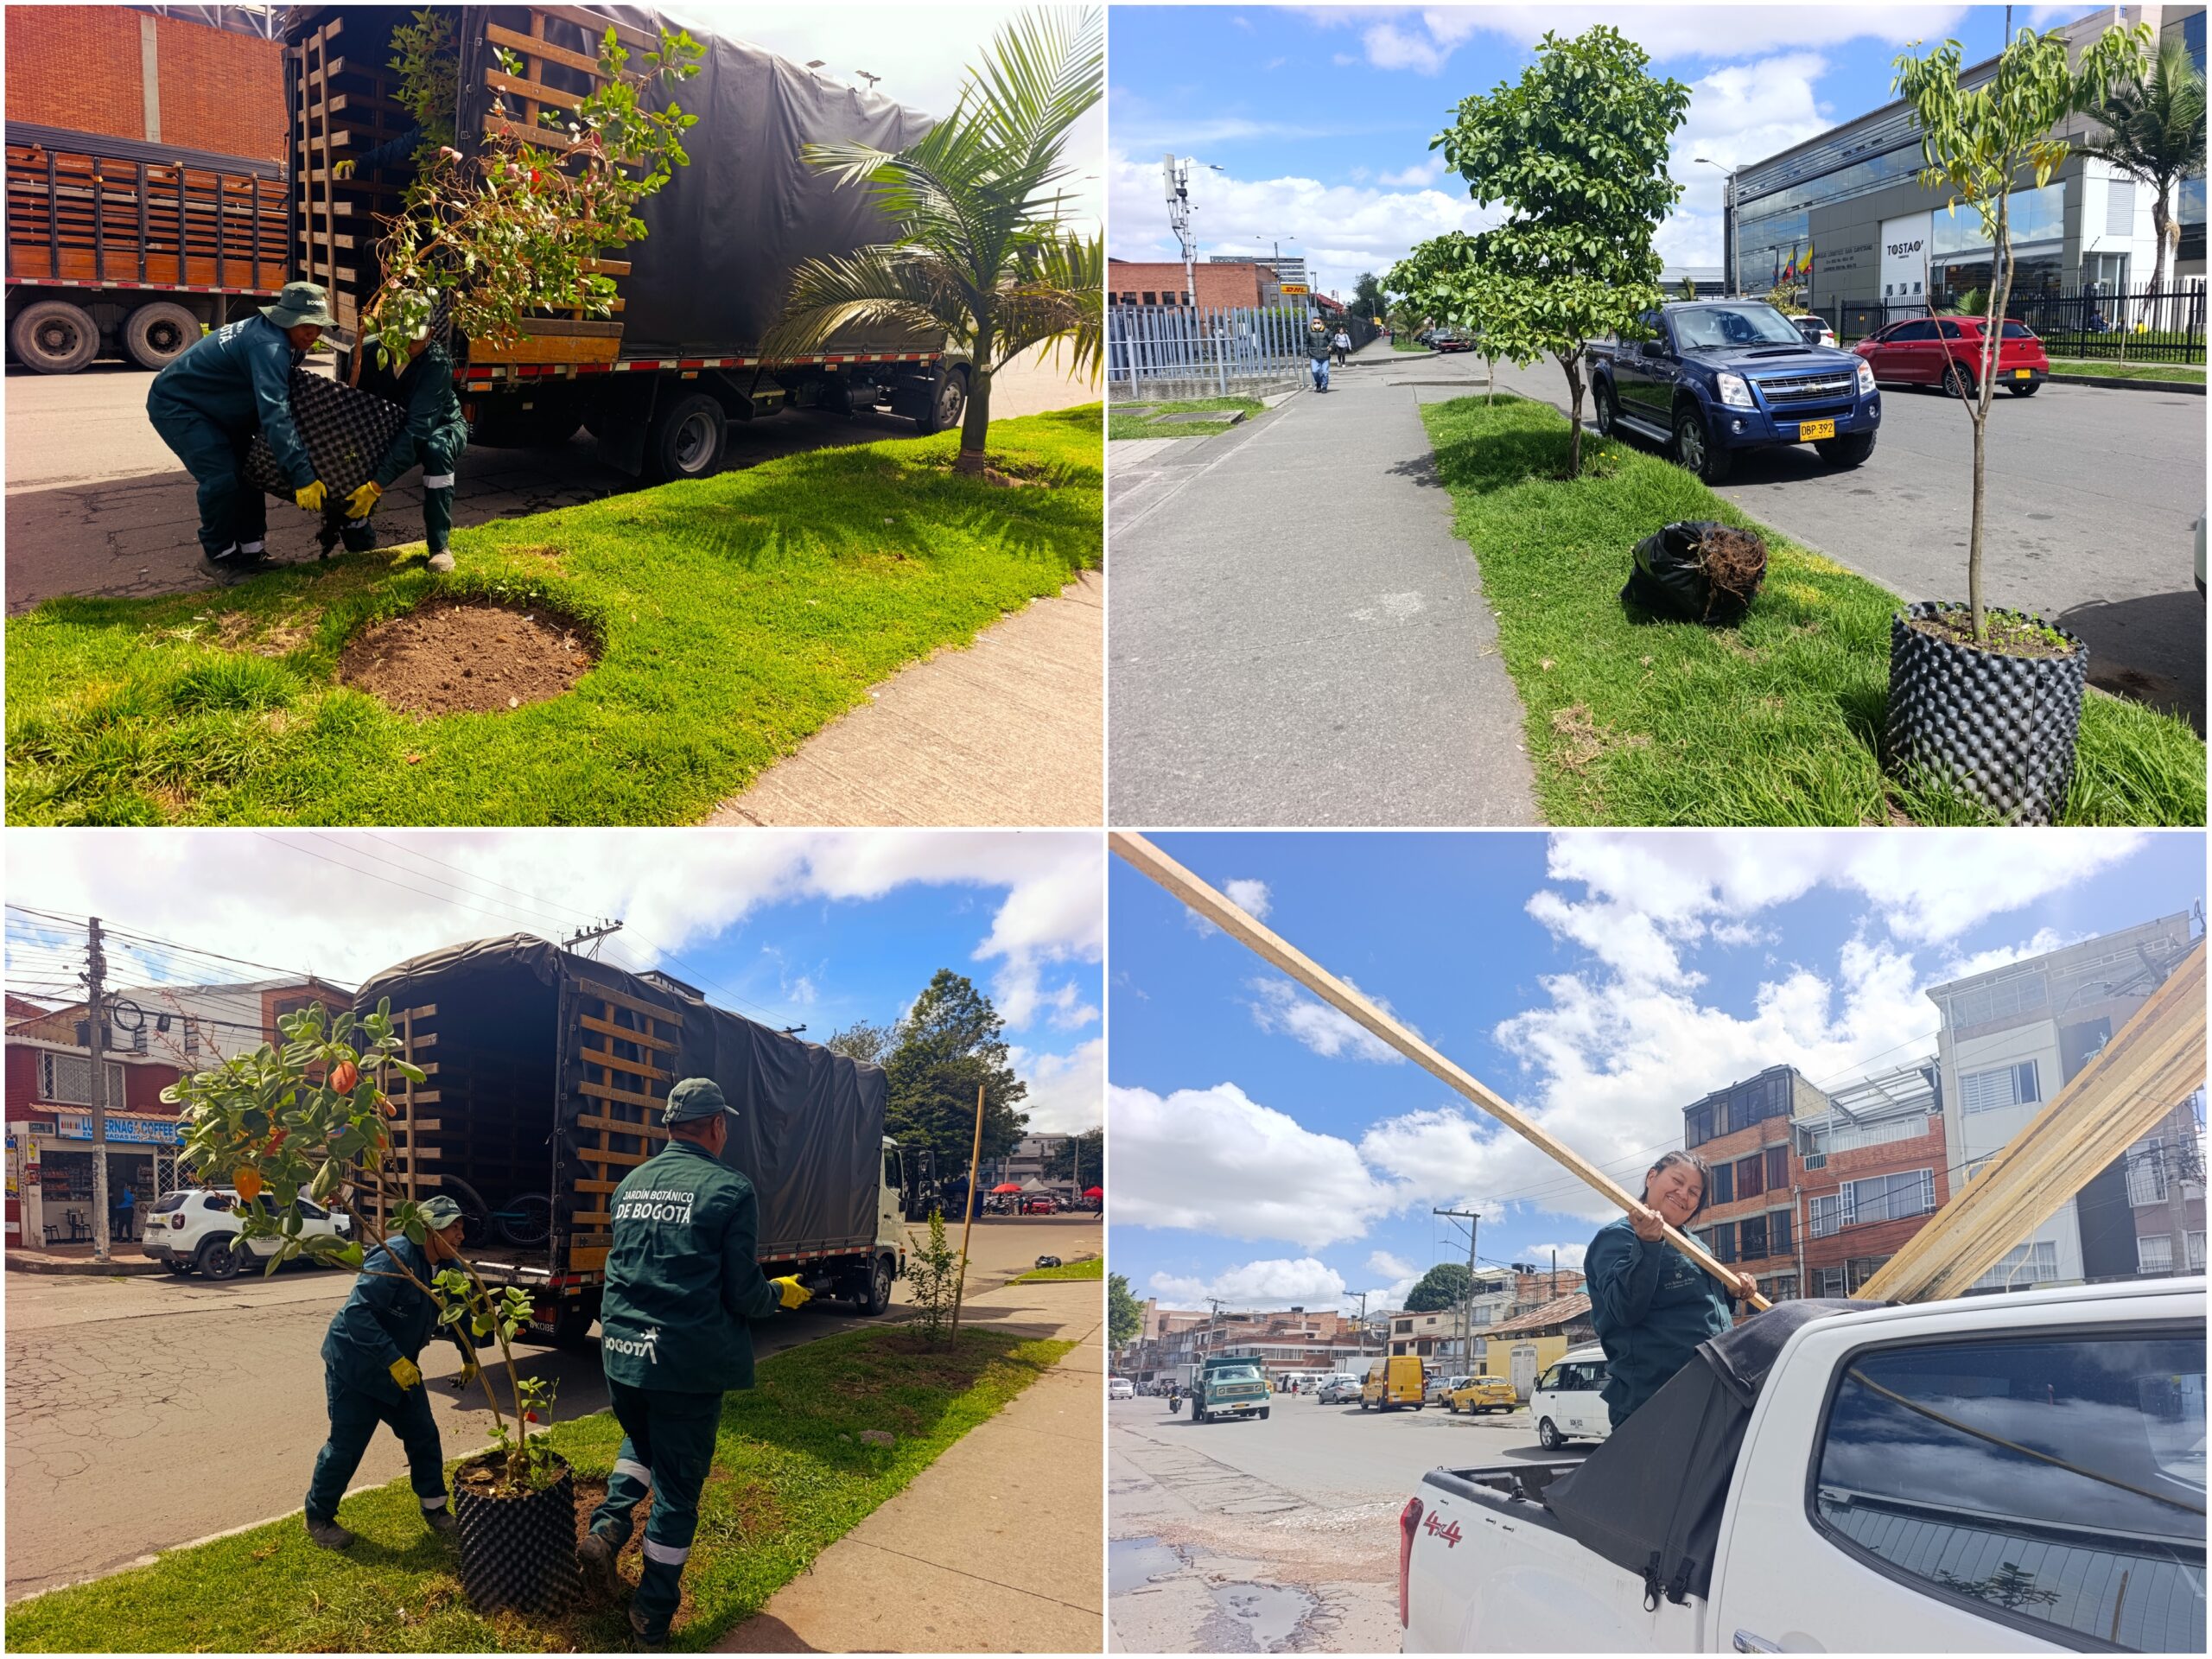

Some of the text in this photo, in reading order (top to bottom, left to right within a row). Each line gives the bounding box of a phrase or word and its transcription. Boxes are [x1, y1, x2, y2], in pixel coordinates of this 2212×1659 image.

[141, 1122, 174, 1136] COFFEE
[623, 1189, 695, 1203] JARDÍN BOTÁNICO
[615, 1203, 692, 1224] DE BOGOTÁ
[1423, 1510, 1463, 1548] 4x4
